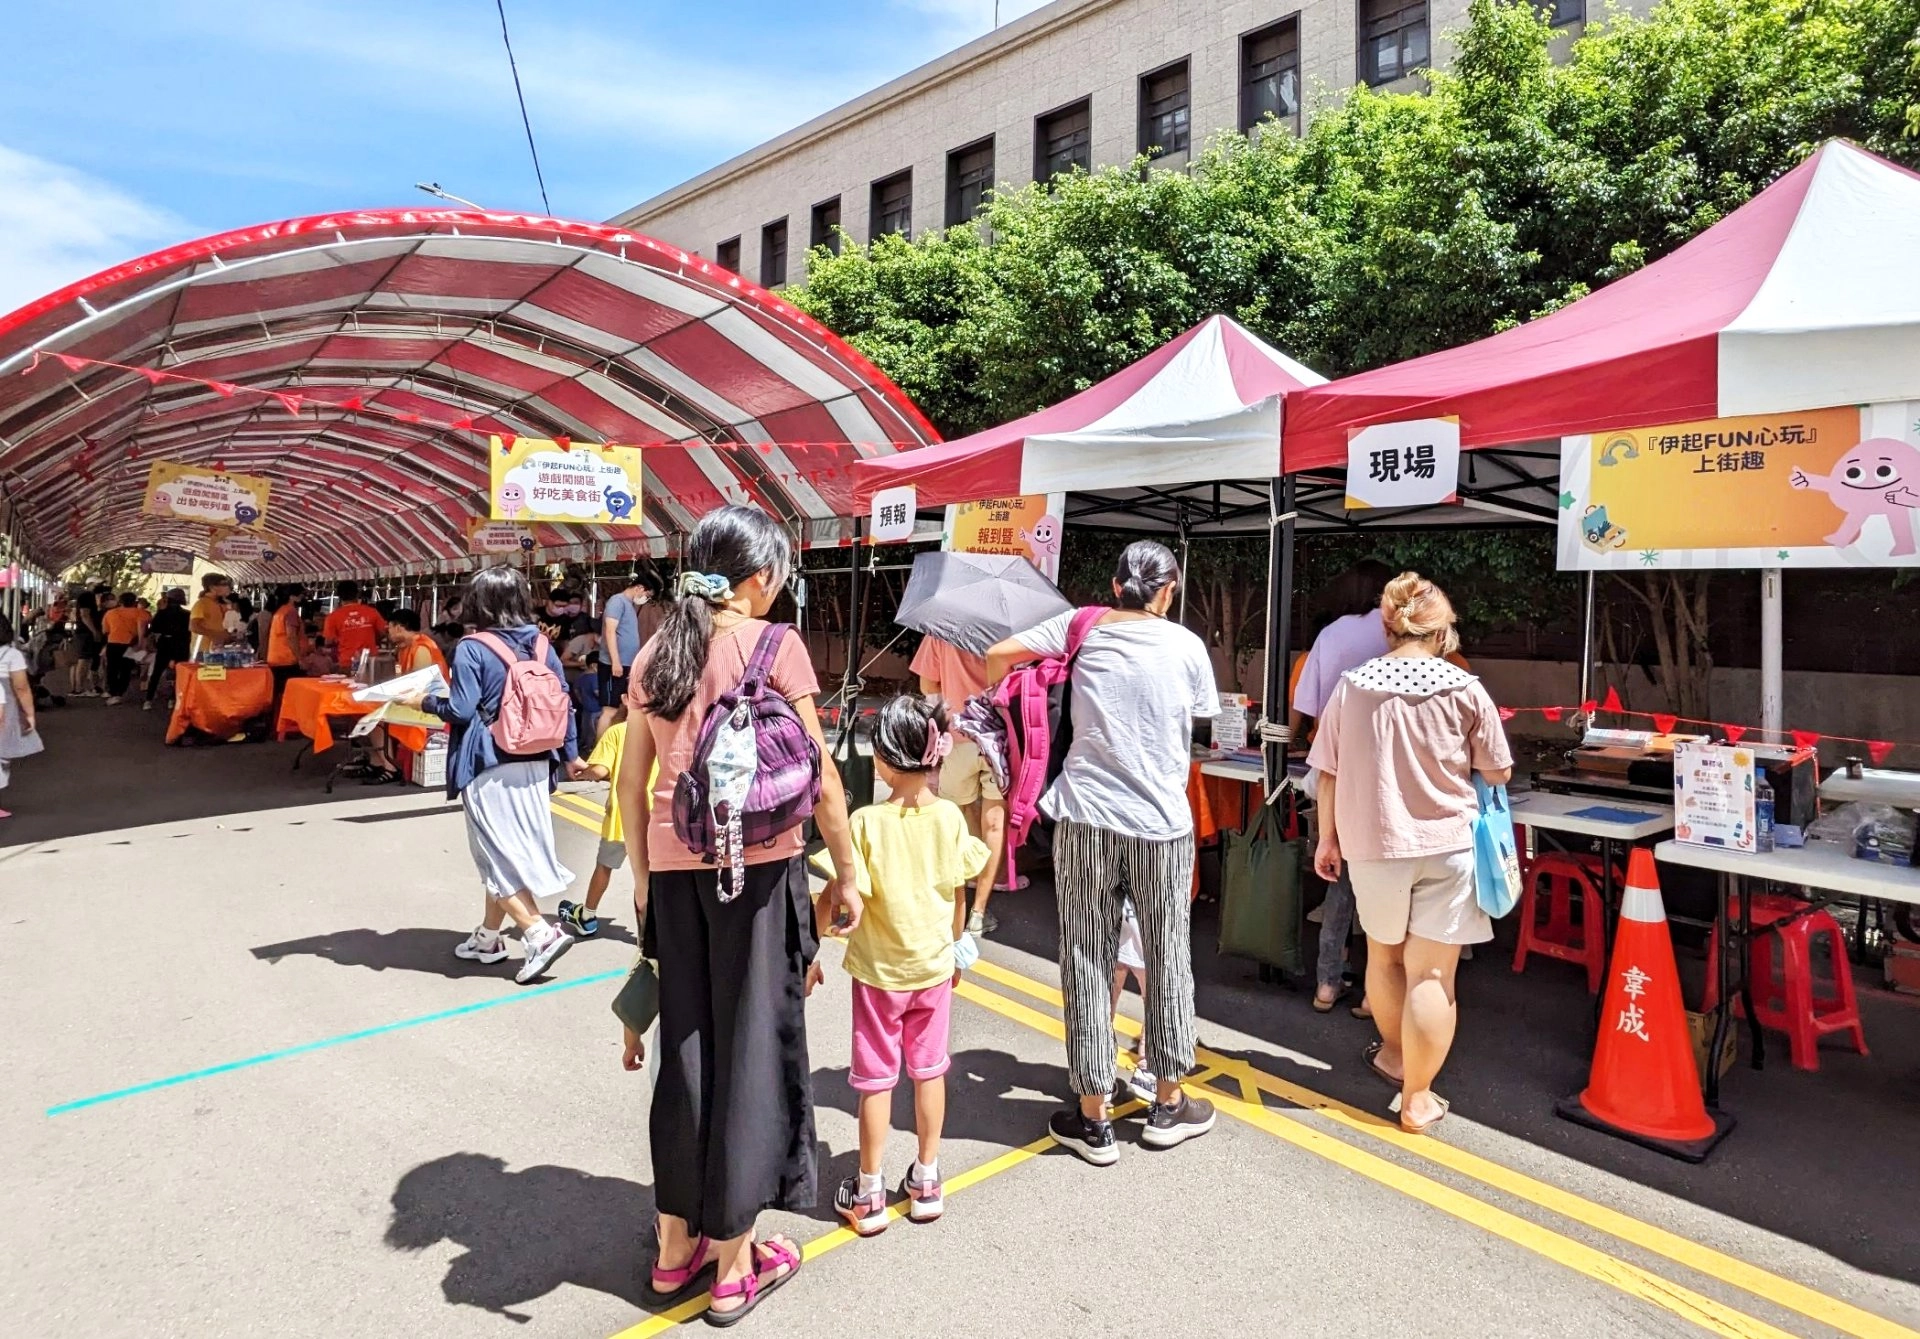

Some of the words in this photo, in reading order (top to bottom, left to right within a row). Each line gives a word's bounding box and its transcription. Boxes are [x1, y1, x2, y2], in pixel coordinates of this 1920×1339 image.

[1648, 424, 1818, 455] 『伊起FUN心玩』
[1368, 444, 1436, 482] 現場
[1693, 450, 1766, 474] 上街趣
[176, 496, 230, 511] 出發吧列車
[532, 486, 601, 503] 好吃美食街
[879, 503, 906, 527] 預報
[988, 510, 1010, 522] 上街趣
[977, 527, 1014, 545] 報到暨
[1615, 965, 1652, 1042] 韋成
